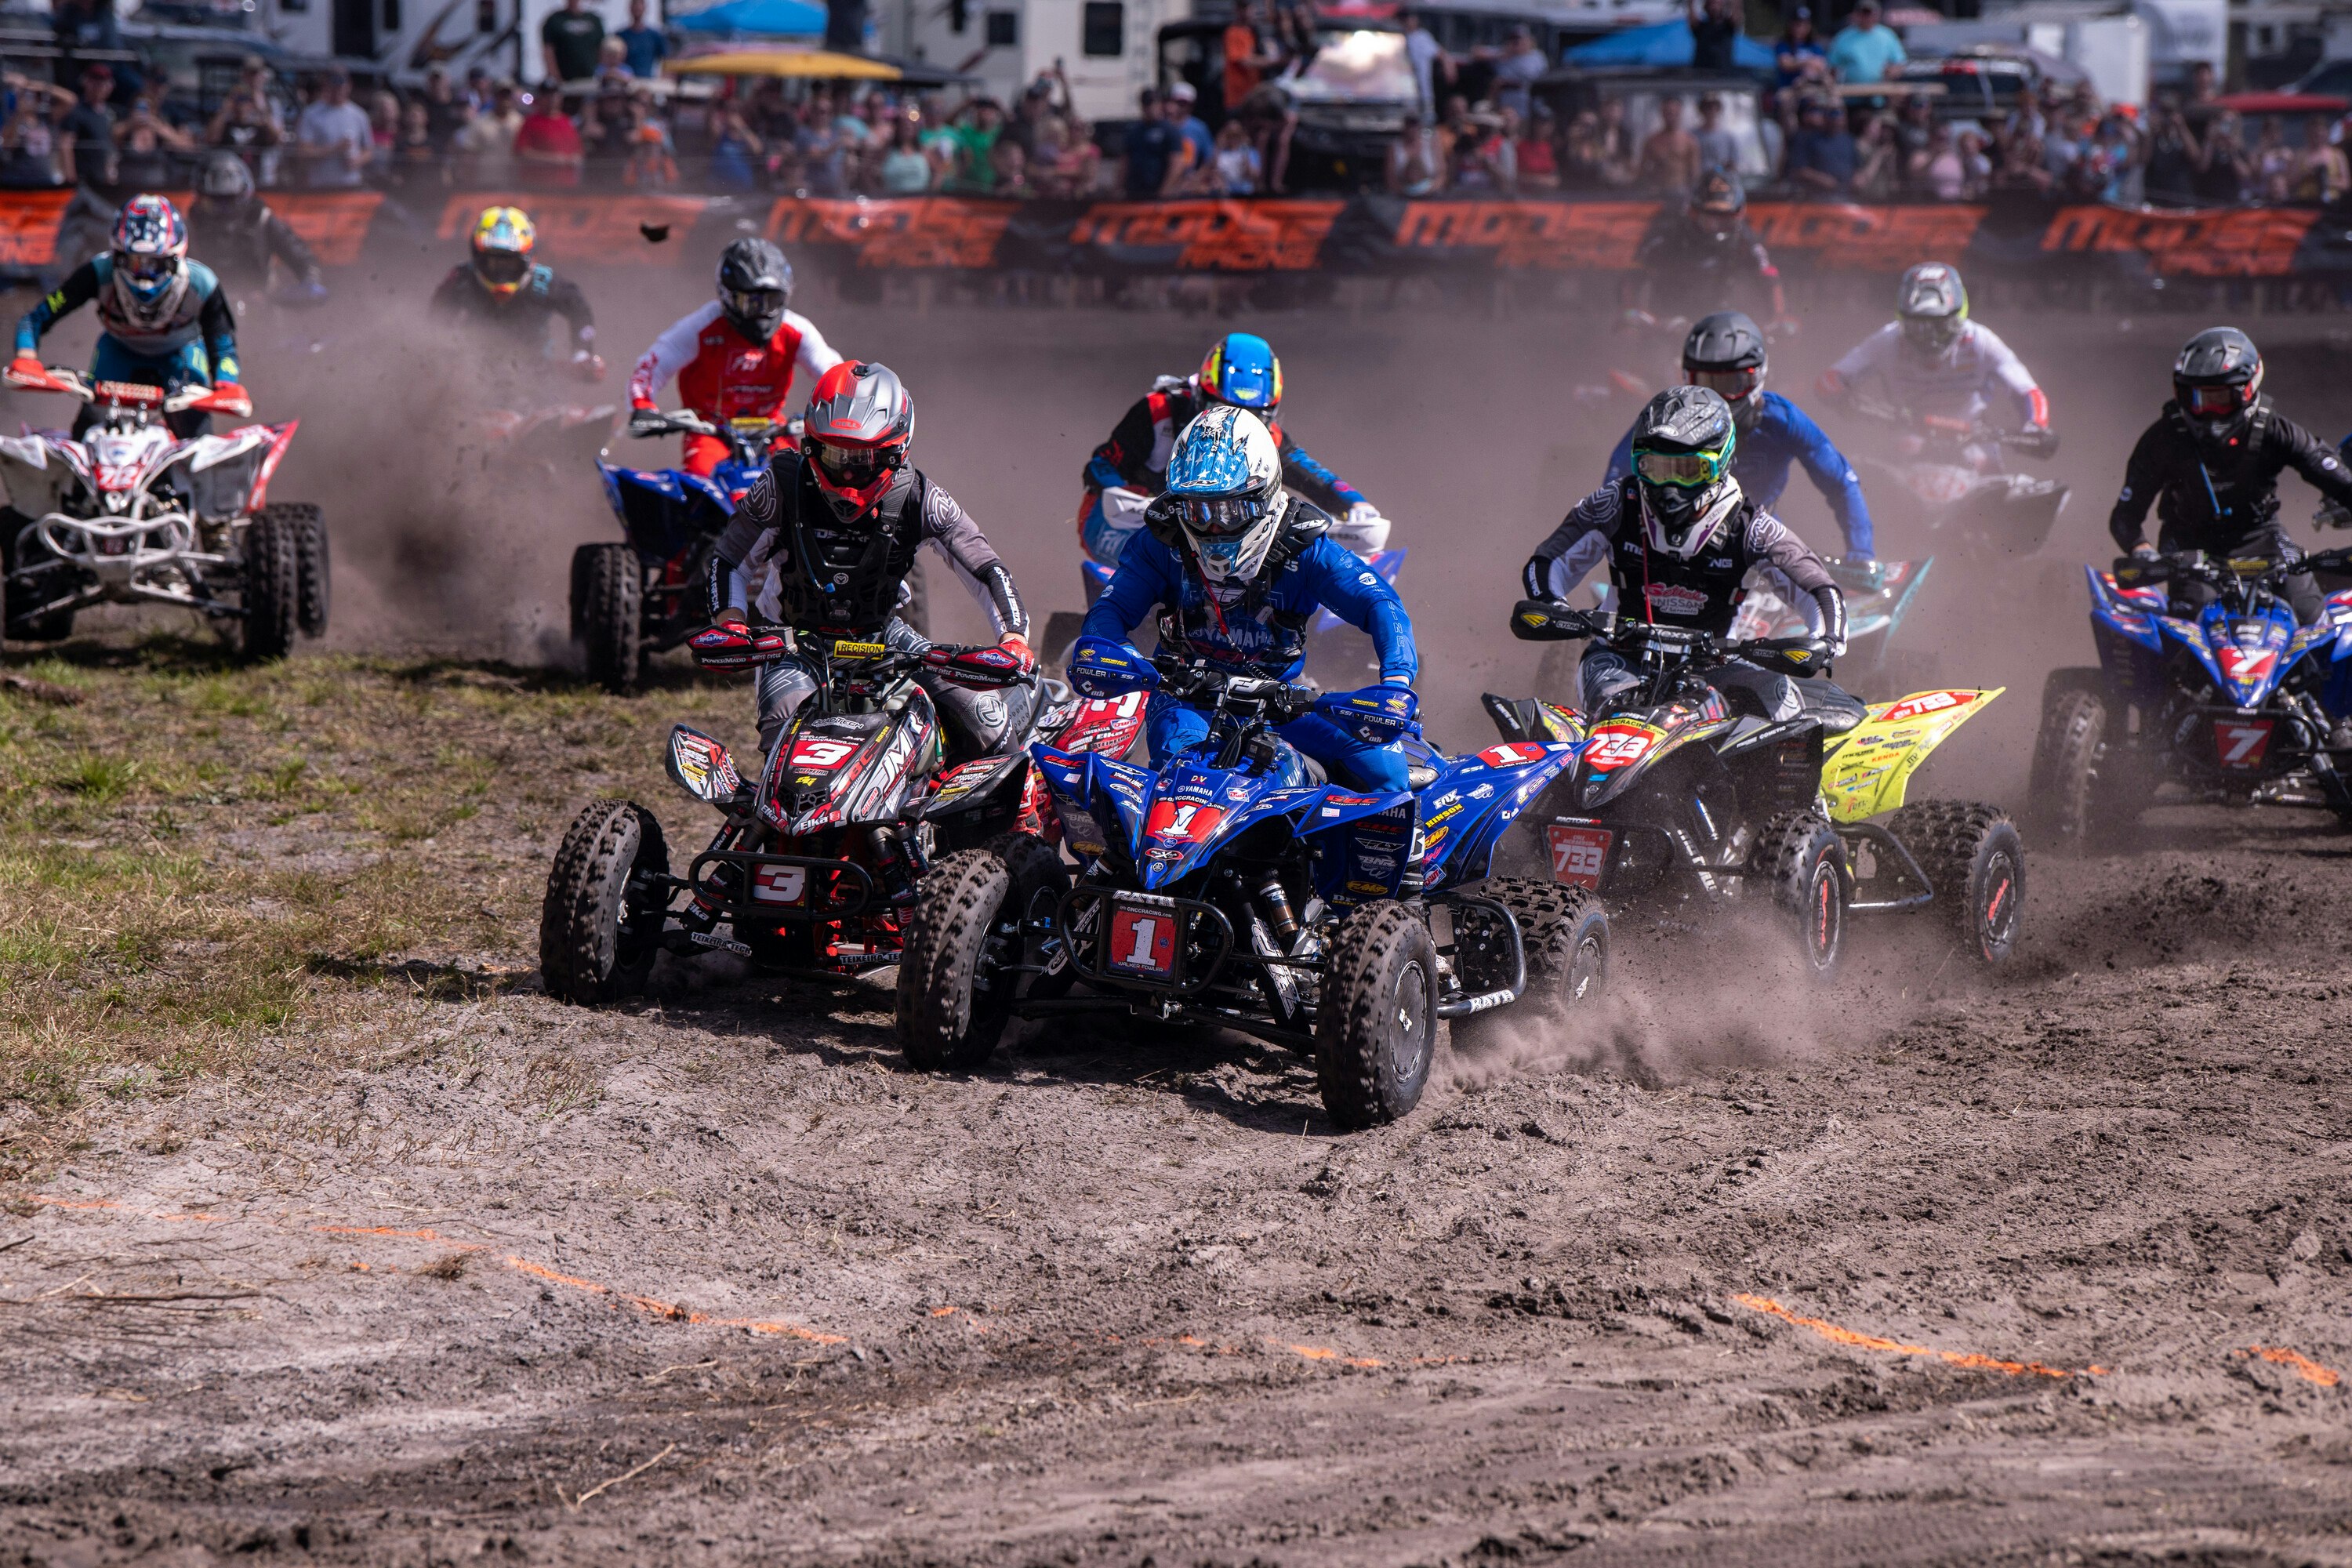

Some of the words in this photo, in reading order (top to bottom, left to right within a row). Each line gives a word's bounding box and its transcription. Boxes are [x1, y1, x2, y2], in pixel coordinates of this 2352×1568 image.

[1657, 597, 1703, 608] NISSAN
[2230, 650, 2274, 673] 7
[1076, 667, 1106, 677] FOWLER
[1364, 714, 1396, 726] FOWLER
[1096, 731, 1123, 740] Elka
[1759, 725, 1787, 740] COMETIC
[1585, 732, 1650, 759] 733
[2223, 728, 2268, 761] 7
[792, 742, 853, 766] 3
[1043, 755, 1087, 767] GBC
[1489, 745, 1528, 764] 1
[1871, 752, 1900, 763] KENDA
[1461, 765, 1484, 775] SSI
[1113, 772, 1145, 789] YAMALUBE
[1185, 786, 1214, 797] YAMAHA
[1326, 794, 1381, 804] GBC
[1434, 789, 1464, 810] FOX
[862, 787, 879, 816] BALDWIN
[760, 804, 779, 822] Elka
[1162, 805, 1198, 835] 1
[1425, 804, 1464, 829] HINSON
[800, 817, 829, 831] Elka
[712, 833, 728, 851] Elka
[902, 840, 914, 860] Elka
[1555, 843, 1603, 876] 733
[754, 864, 806, 902] 3
[1348, 881, 1388, 895] FMF
[688, 903, 710, 921] Elka
[1127, 906, 1172, 918] GNCCRACING.COM
[692, 933, 728, 949] TEIXEIRA
[730, 942, 752, 956] TECH
[1126, 918, 1157, 967] 1
[841, 953, 884, 965] TEIXEIRA
